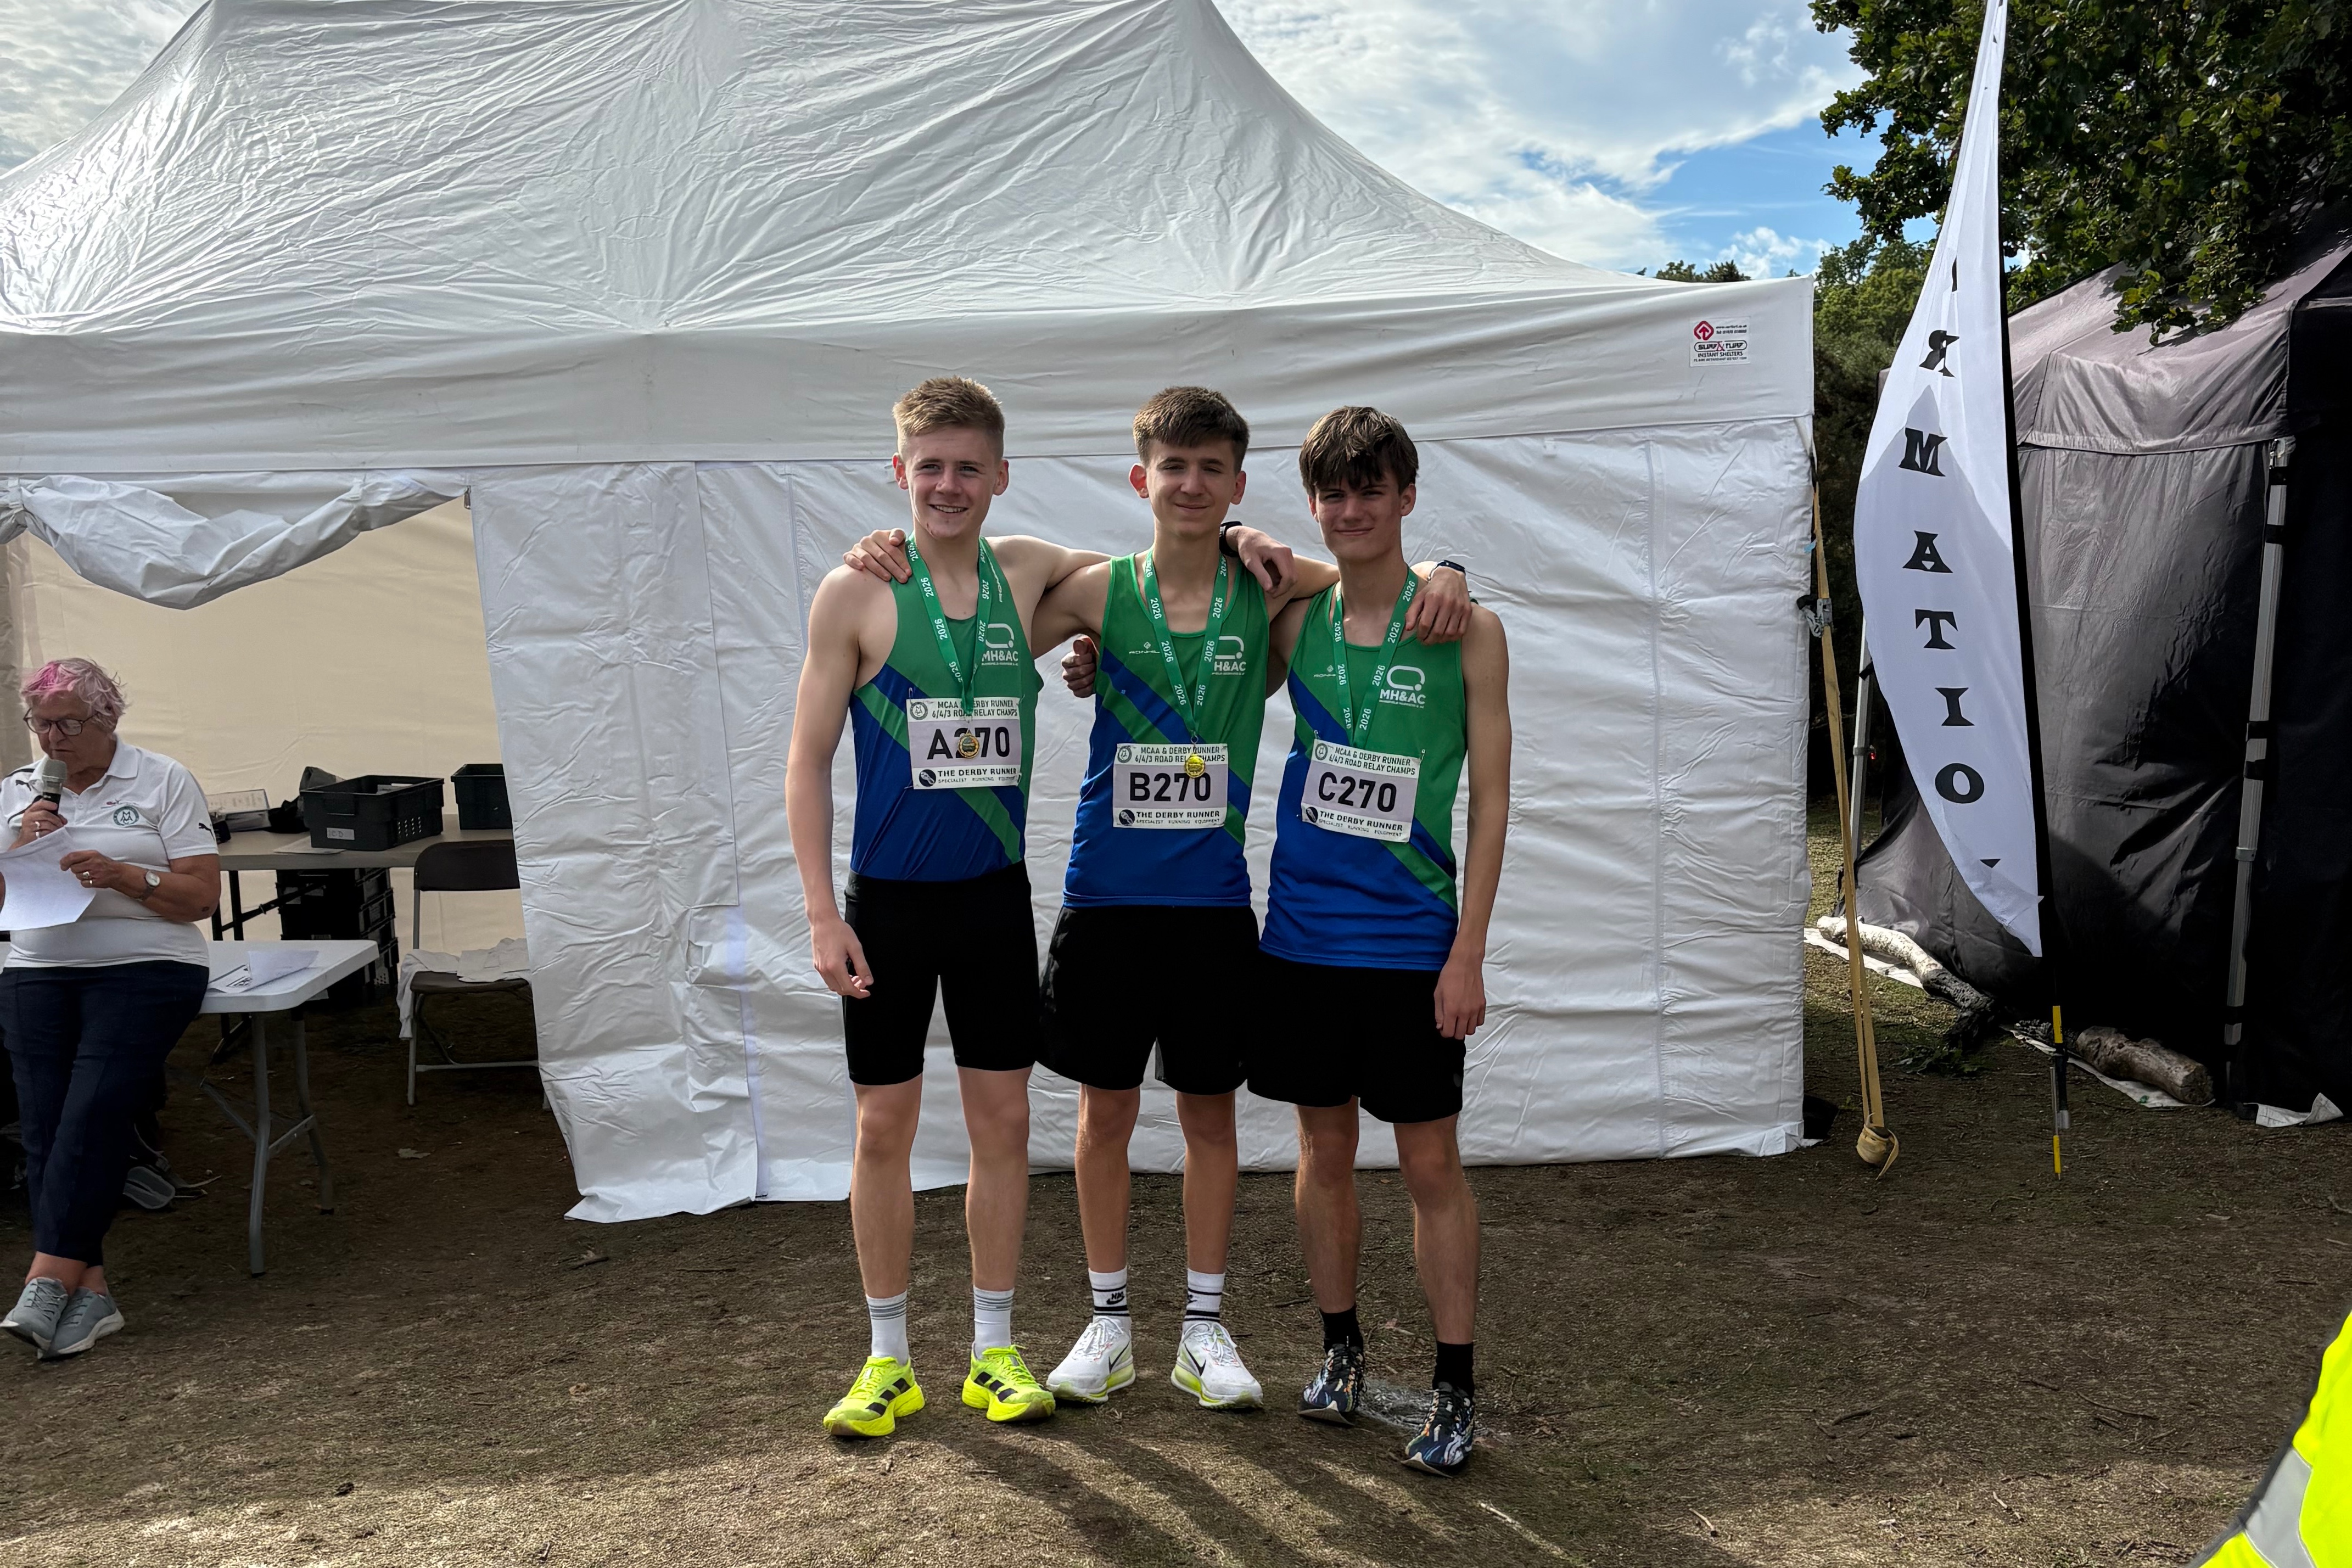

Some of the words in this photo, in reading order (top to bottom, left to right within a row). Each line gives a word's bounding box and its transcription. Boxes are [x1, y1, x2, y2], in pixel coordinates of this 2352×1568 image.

[921, 578, 934, 597] 2026
[1403, 580, 1415, 602] 2026
[1212, 597, 1223, 618] 2026
[934, 618, 948, 640] 2026
[1387, 622, 1401, 643] 2026
[981, 650, 1018, 662] MH&AC
[1161, 640, 1174, 663] 2026
[1204, 640, 1215, 662] 2026
[1214, 661, 1246, 671] H&AC
[1380, 688, 1426, 704] MH&AC
[932, 709, 951, 719] 6/4/3
[1135, 755, 1152, 763] 6/4/3
[1335, 746, 1351, 757] MCAA
[1359, 752, 1381, 763] DERBY
[1382, 756, 1411, 766] RUNNER
[1345, 758, 1362, 768] ROAD
[1363, 762, 1385, 772] RELAY
[1386, 765, 1416, 775] CHAMPS
[1130, 772, 1211, 802] B270
[1318, 771, 1397, 813] C270
[1320, 810, 1334, 820] THE
[1337, 815, 1364, 825] DERBY
[1367, 820, 1403, 831] RUNNER
